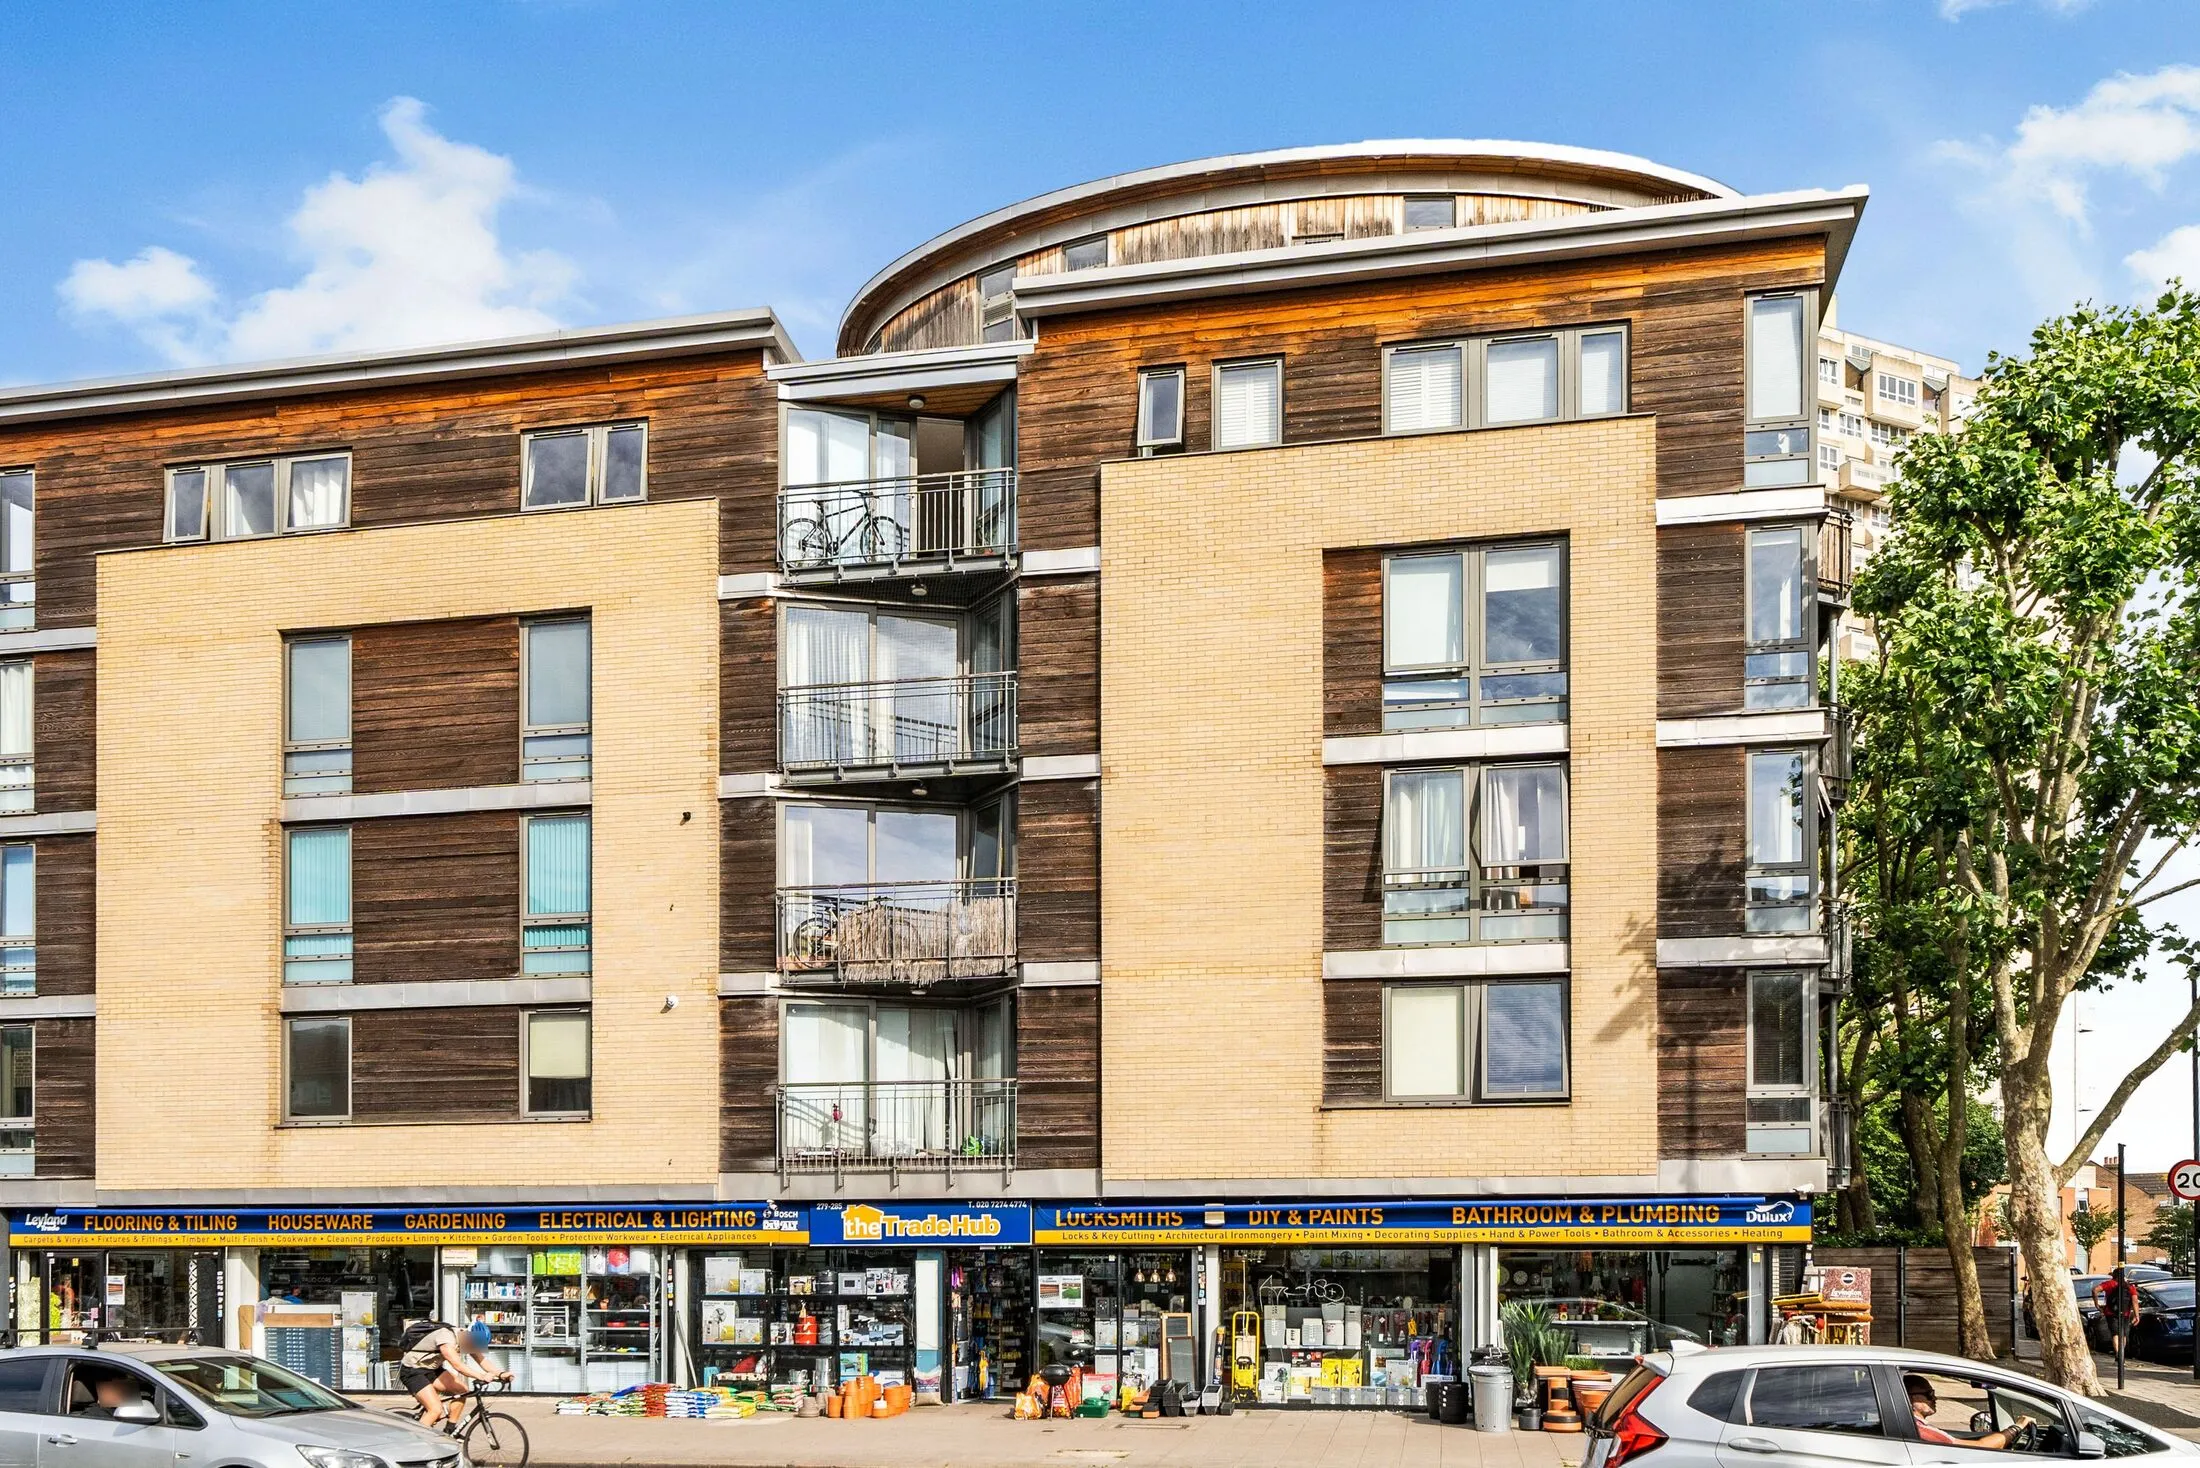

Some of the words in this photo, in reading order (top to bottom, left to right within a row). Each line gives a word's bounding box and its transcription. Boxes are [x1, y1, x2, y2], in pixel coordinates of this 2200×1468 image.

[816, 1202, 843, 1210] 279-285
[991, 1200, 1009, 1208] 7274
[1009, 1200, 1028, 1208] 4774
[25, 1213, 68, 1228] Leyland
[404, 1213, 506, 1229] GARDENING
[539, 1211, 648, 1228] ELECTRICAL
[652, 1211, 666, 1228] &
[670, 1210, 756, 1228] LIGHTING
[774, 1210, 799, 1218] BOSCH
[1248, 1210, 1281, 1225] DIY
[1287, 1209, 1303, 1225] &
[1309, 1208, 1384, 1225] PAINTS
[1452, 1206, 1573, 1224] BATHROOM
[1579, 1206, 1596, 1223] &
[1602, 1204, 1720, 1224] PLUMBING
[1746, 1210, 1788, 1223] Dulux
[83, 1215, 164, 1231] FLOORING
[168, 1215, 180, 1231] &
[183, 1214, 237, 1231] TILING
[267, 1214, 374, 1230] HOUSEWARE
[24, 1236, 54, 1244] Carpets
[65, 1236, 89, 1244] Vinyls
[97, 1235, 130, 1243] Fixtures
[133, 1235, 138, 1243] &
[141, 1235, 172, 1244] Fittings
[182, 1235, 209, 1243] Timber
[219, 1235, 240, 1243] Multi
[243, 1235, 268, 1243] Finish
[276, 1235, 318, 1243] Cookware
[326, 1235, 363, 1244] Cleaning
[366, 1235, 404, 1243] Products
[413, 1234, 440, 1244] Lining
[449, 1234, 482, 1242] Kitchen
[492, 1234, 523, 1242] Garden
[526, 1234, 549, 1242] Tools
[559, 1233, 604, 1242] Protective
[606, 1233, 649, 1241] Workwear
[660, 1233, 704, 1241] Electrical
[707, 1232, 757, 1242] Appliances
[1062, 1232, 1089, 1240] Locks
[1092, 1232, 1098, 1240] &
[1101, 1232, 1119, 1241] Key
[1121, 1232, 1155, 1241] Cutting
[1165, 1231, 1228, 1240] Architectural
[1230, 1231, 1293, 1241] Ironmongery
[1303, 1231, 1328, 1239] Paint
[1331, 1230, 1363, 1241] Mixing
[1374, 1230, 1430, 1240] Decorating
[1433, 1230, 1478, 1240] Supplies
[1489, 1229, 1515, 1238] Hand
[1518, 1229, 1525, 1238] &
[1528, 1229, 1561, 1238] Power
[1564, 1229, 1591, 1238] Tools
[1602, 1229, 1653, 1238] Bathroom
[1656, 1229, 1664, 1238] &
[1667, 1229, 1730, 1238] Accessories
[1742, 1228, 1783, 1240] Heating
